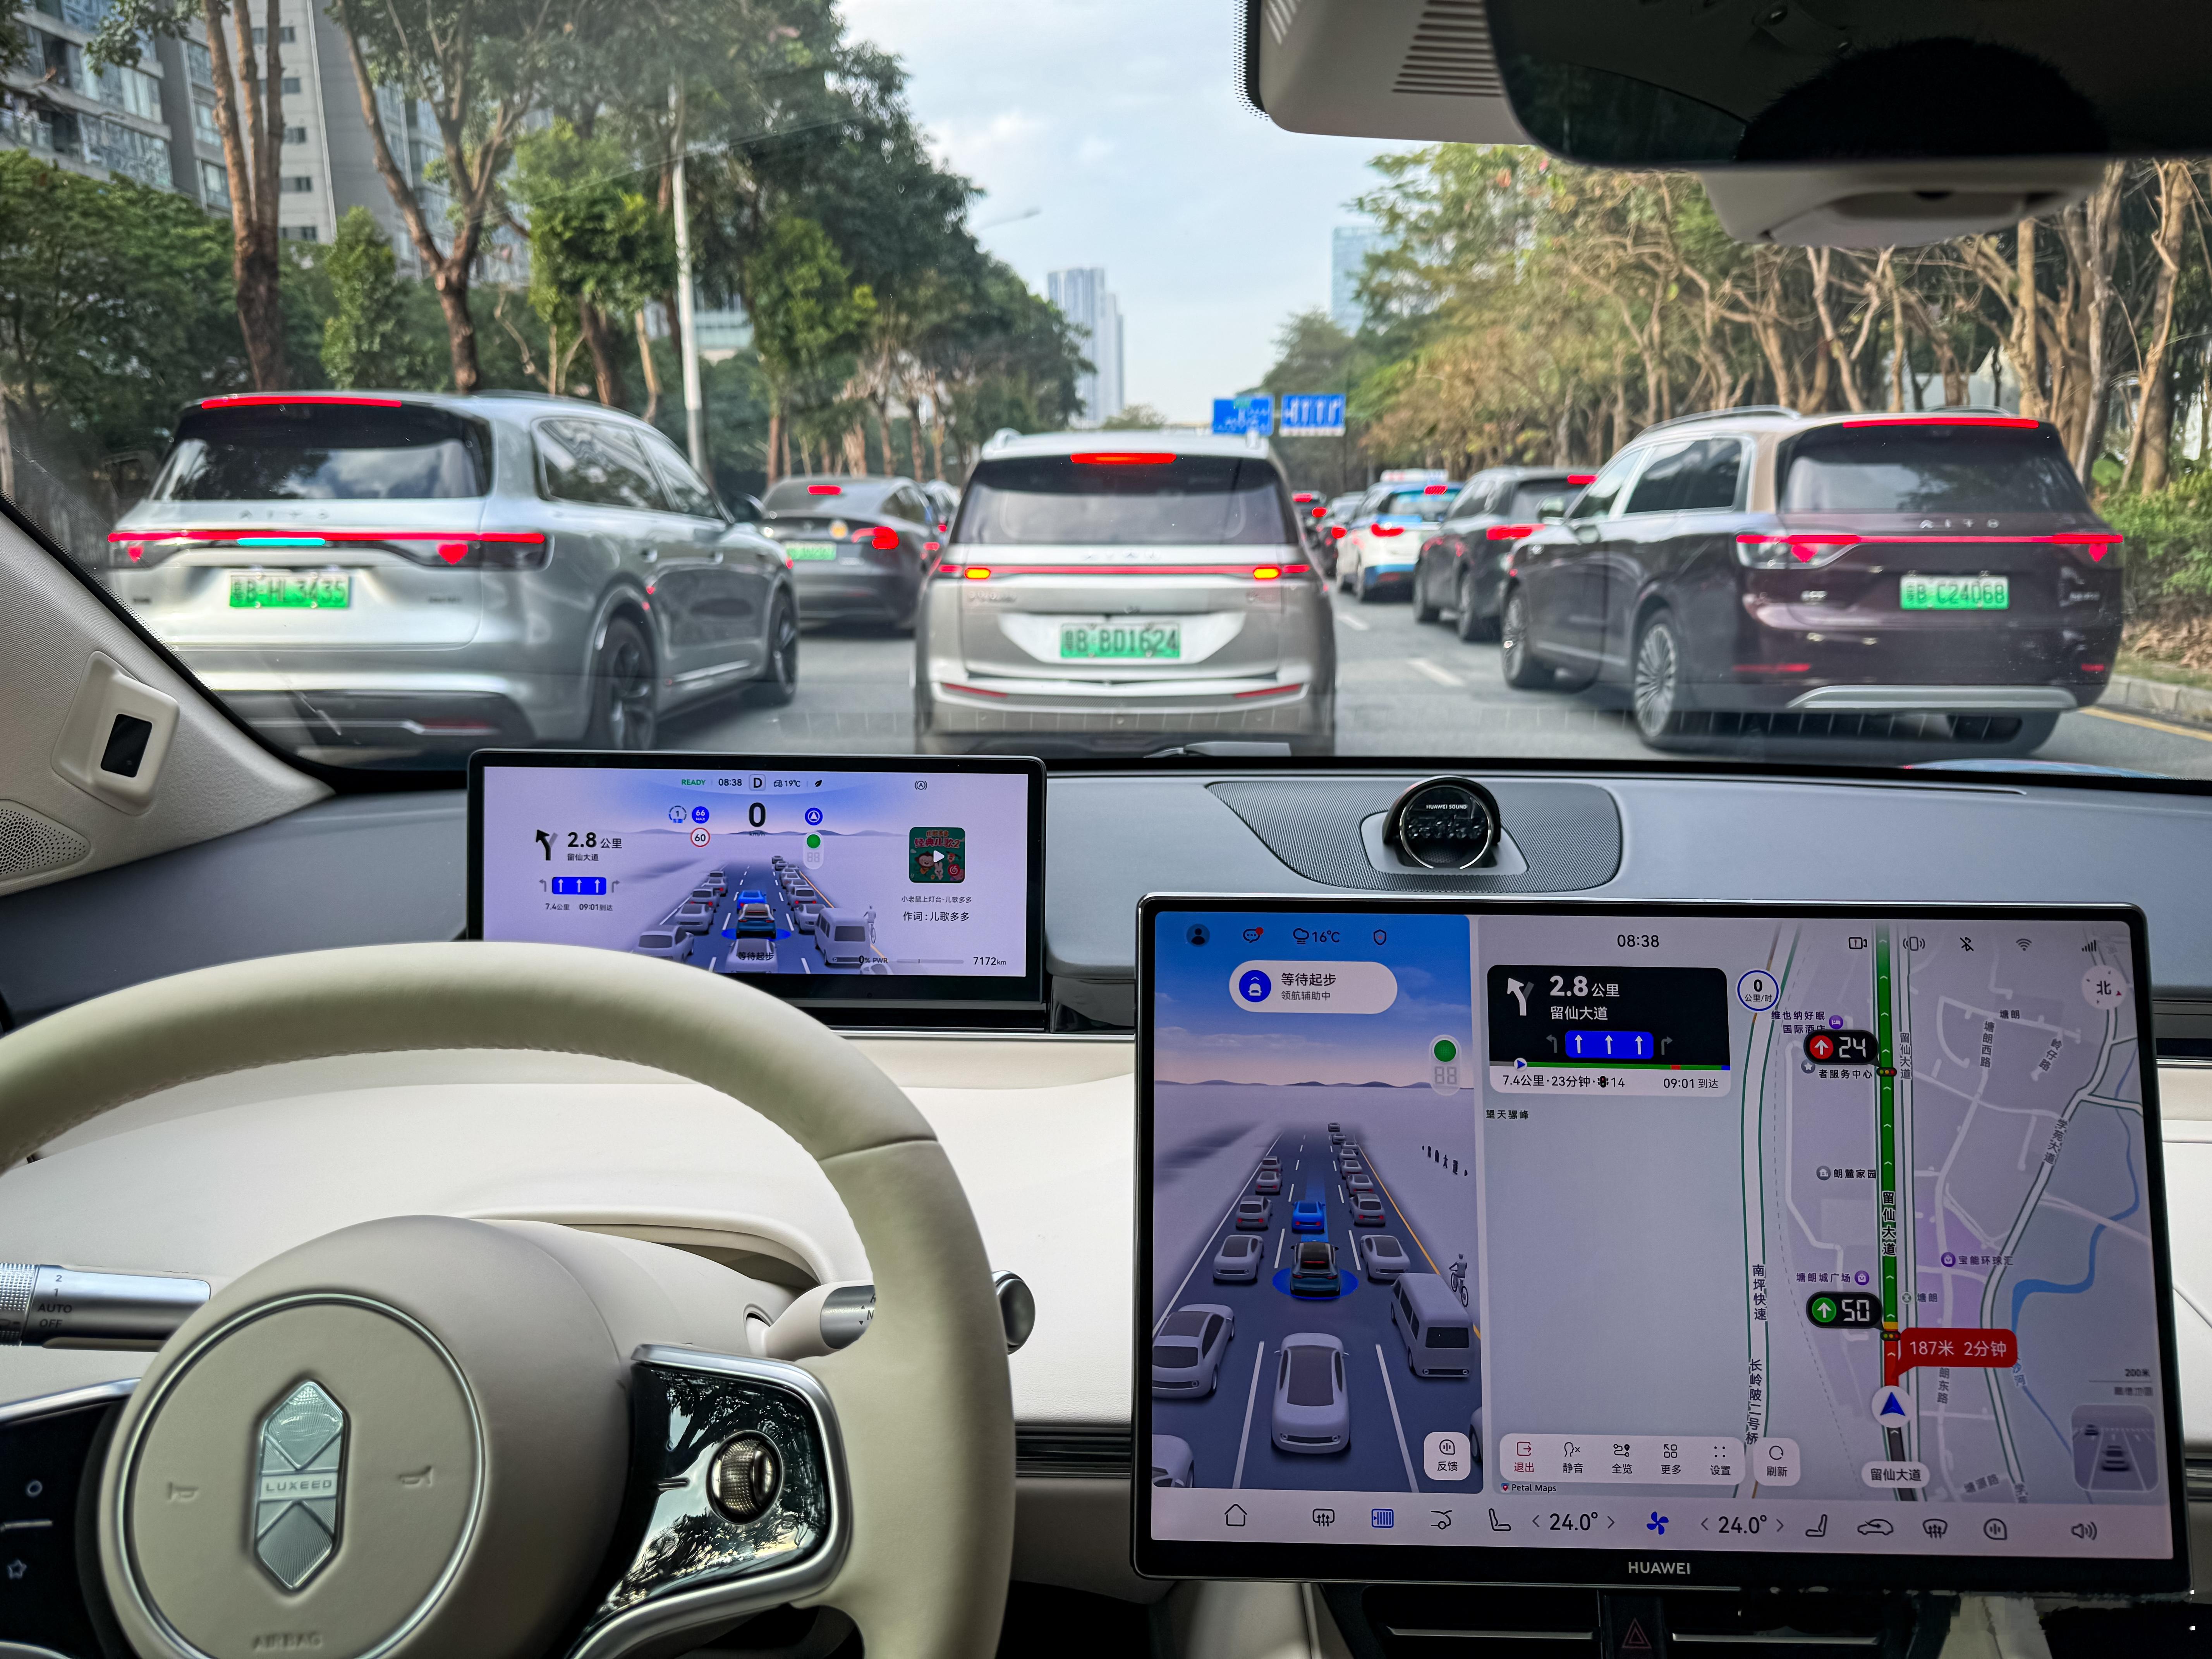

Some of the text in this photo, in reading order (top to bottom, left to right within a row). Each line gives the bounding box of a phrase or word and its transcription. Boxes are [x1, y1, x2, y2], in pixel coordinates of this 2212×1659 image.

[753, 777, 763, 788] D
[749, 802, 766, 827] 0
[567, 832, 622, 849] 2.8 公里
[1617, 934, 1660, 948] 08:38
[738, 952, 775, 961] 等待起步
[1281, 972, 1337, 986] 等待起步
[1549, 975, 1620, 998] 2.8 公里
[1753, 979, 1763, 992] 0
[2096, 981, 2112, 995] 北
[1281, 991, 1331, 1001] 领航辅助中
[1745, 994, 1772, 1002] 公里/时
[1551, 1006, 1608, 1021] 留仙大道
[1771, 1010, 1825, 1020] 维也纳好眠
[1999, 1009, 2020, 1020] 塘朗
[1839, 1037, 1866, 1058] 24
[1980, 1021, 1995, 1068] 塘朗西路
[1900, 1033, 1911, 1080] 留仙大道
[1819, 1069, 1873, 1079] 者服务中心
[1611, 1077, 1625, 1088] 14
[1663, 1078, 1719, 1089] 09:01 到达
[1834, 1169, 1877, 1179] 朗麓家园
[1882, 1191, 1896, 1256] 留仙大道
[1958, 1255, 2013, 1266] 宝能环球汇
[1796, 1273, 1851, 1283] 塘朗城广场
[54, 1288, 58, 1297] 1
[1752, 1264, 1767, 1321] 南坪快速
[1917, 1293, 1938, 1303] 塘朗
[38, 1304, 72, 1313] AUTO
[1841, 1300, 1870, 1321] 50
[40, 1319, 63, 1328] OFF
[1910, 1340, 2007, 1357] 187米 2分钟
[1745, 1358, 1762, 1445] 长岭陂二号桥
[1437, 1461, 1458, 1472] 反馈
[1514, 1462, 1534, 1473] 退出
[1563, 1463, 1583, 1474] 静音
[1612, 1464, 1632, 1474] 全览
[1661, 1464, 1681, 1475] 更多
[1710, 1465, 1731, 1476] 设置
[1767, 1466, 1788, 1477] 刷新
[1870, 1468, 1921, 1481] 留仙大道
[266, 1480, 332, 1491] LUXEED
[1512, 1484, 1556, 1493] Petal Maps
[1550, 1511, 1598, 1531] 24.0°
[1718, 1515, 1767, 1534] 24.0°
[1628, 1562, 1691, 1575] HUAWEI
[252, 1632, 323, 1649] AIRBAG
